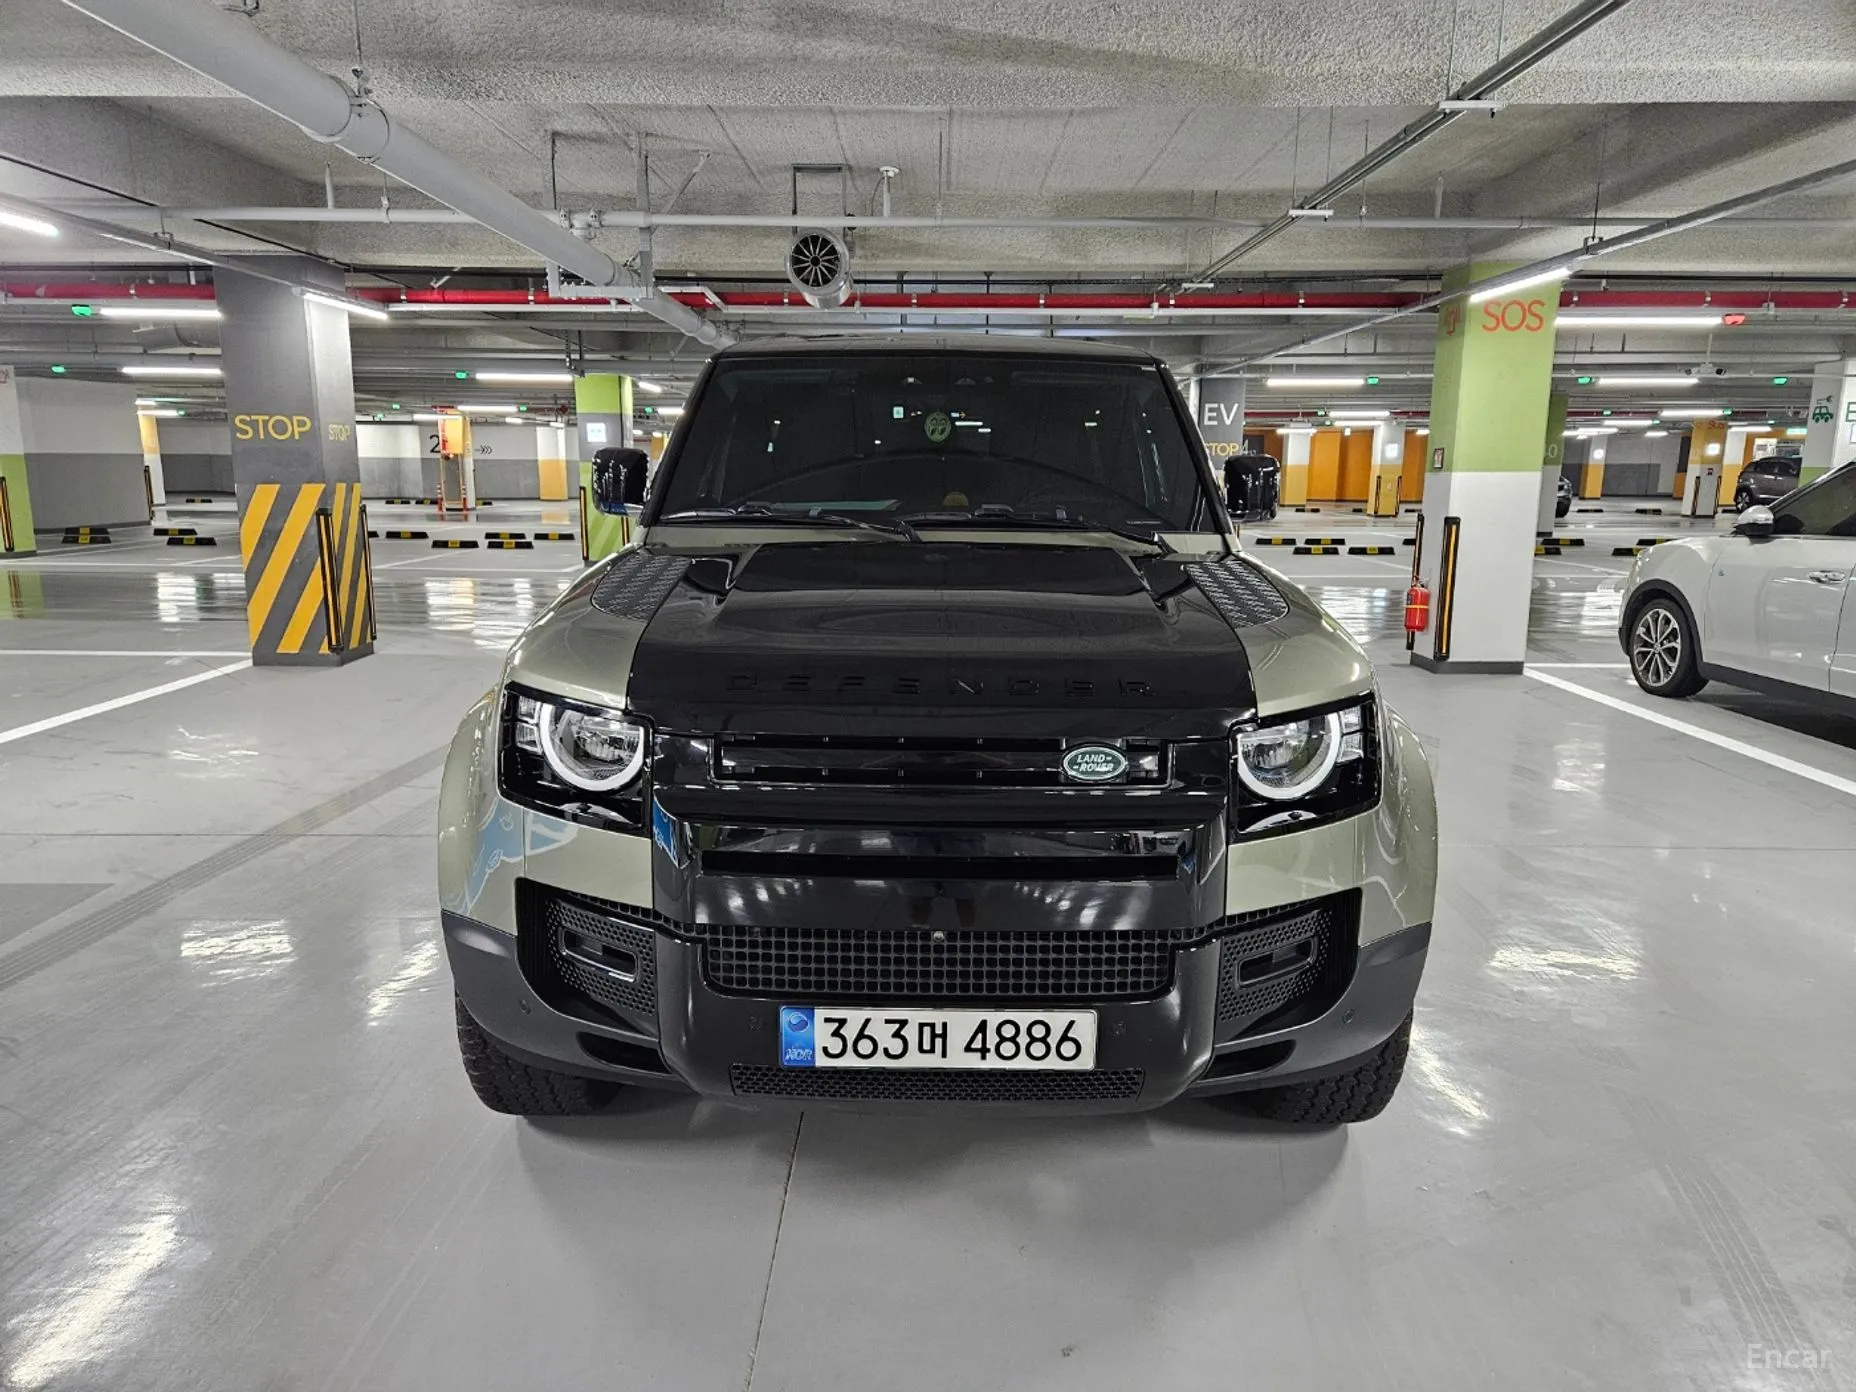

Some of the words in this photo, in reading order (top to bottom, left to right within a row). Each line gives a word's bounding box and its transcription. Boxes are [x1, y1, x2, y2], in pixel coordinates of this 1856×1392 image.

[1482, 299, 1546, 332] SOS
[1203, 403, 1239, 426] EV
[234, 415, 312, 440] STOP
[328, 423, 351, 441] STOP
[1204, 442, 1240, 456] TOP
[726, 673, 1156, 697] DEFENDER
[821, 1017, 948, 1060] 363머
[963, 1019, 1082, 1062] 4886
